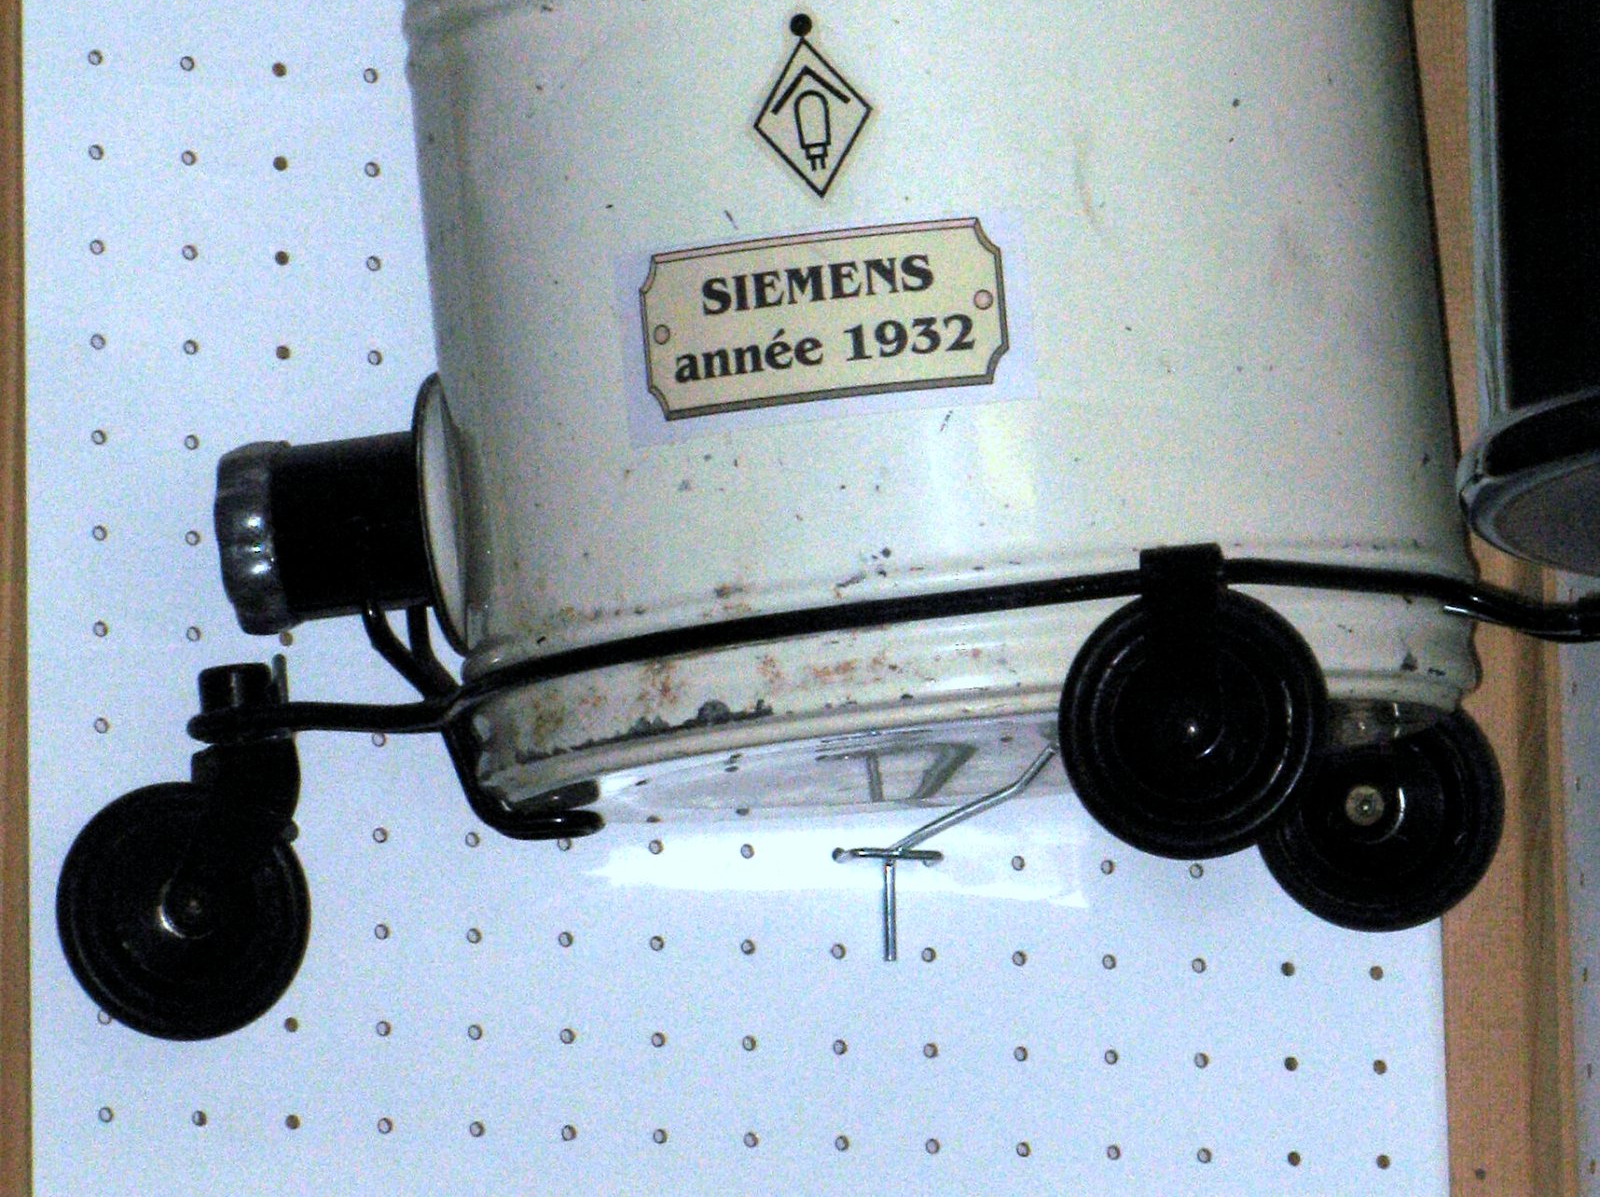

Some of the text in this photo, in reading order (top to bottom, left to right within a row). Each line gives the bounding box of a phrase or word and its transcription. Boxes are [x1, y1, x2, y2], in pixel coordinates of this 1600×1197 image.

[702, 253, 934, 316] SIEMENS
[674, 312, 976, 383] année 1932
